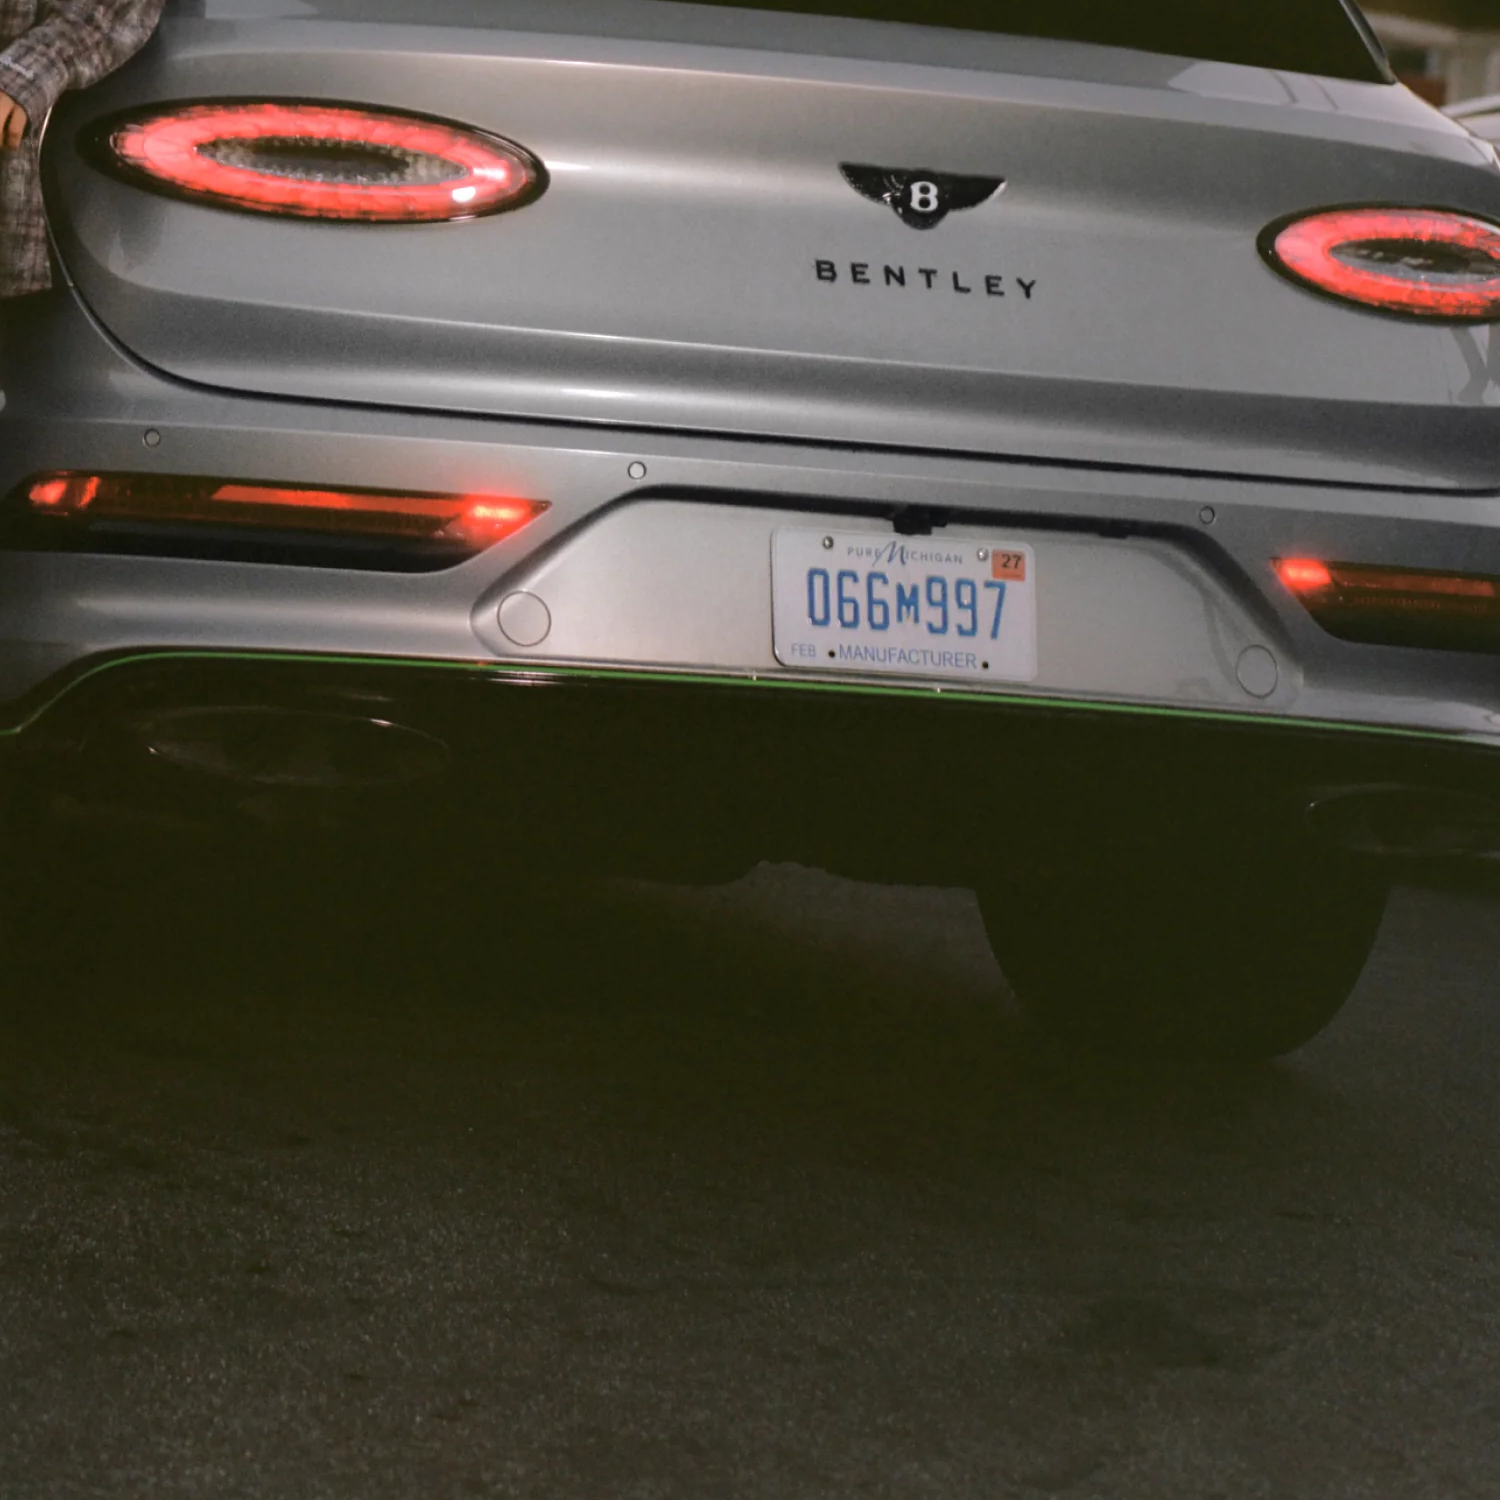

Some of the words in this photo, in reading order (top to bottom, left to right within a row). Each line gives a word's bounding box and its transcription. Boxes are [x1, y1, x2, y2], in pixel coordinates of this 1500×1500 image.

[909, 180, 939, 213] B
[814, 258, 1037, 300] BENTLEY
[846, 545, 880, 558] PURE
[872, 540, 963, 567] MICHIGAN
[1001, 553, 1023, 570] 27
[806, 567, 1007, 641] 066M997
[790, 643, 817, 658] FEB
[838, 643, 978, 670] MANUFACTURER
